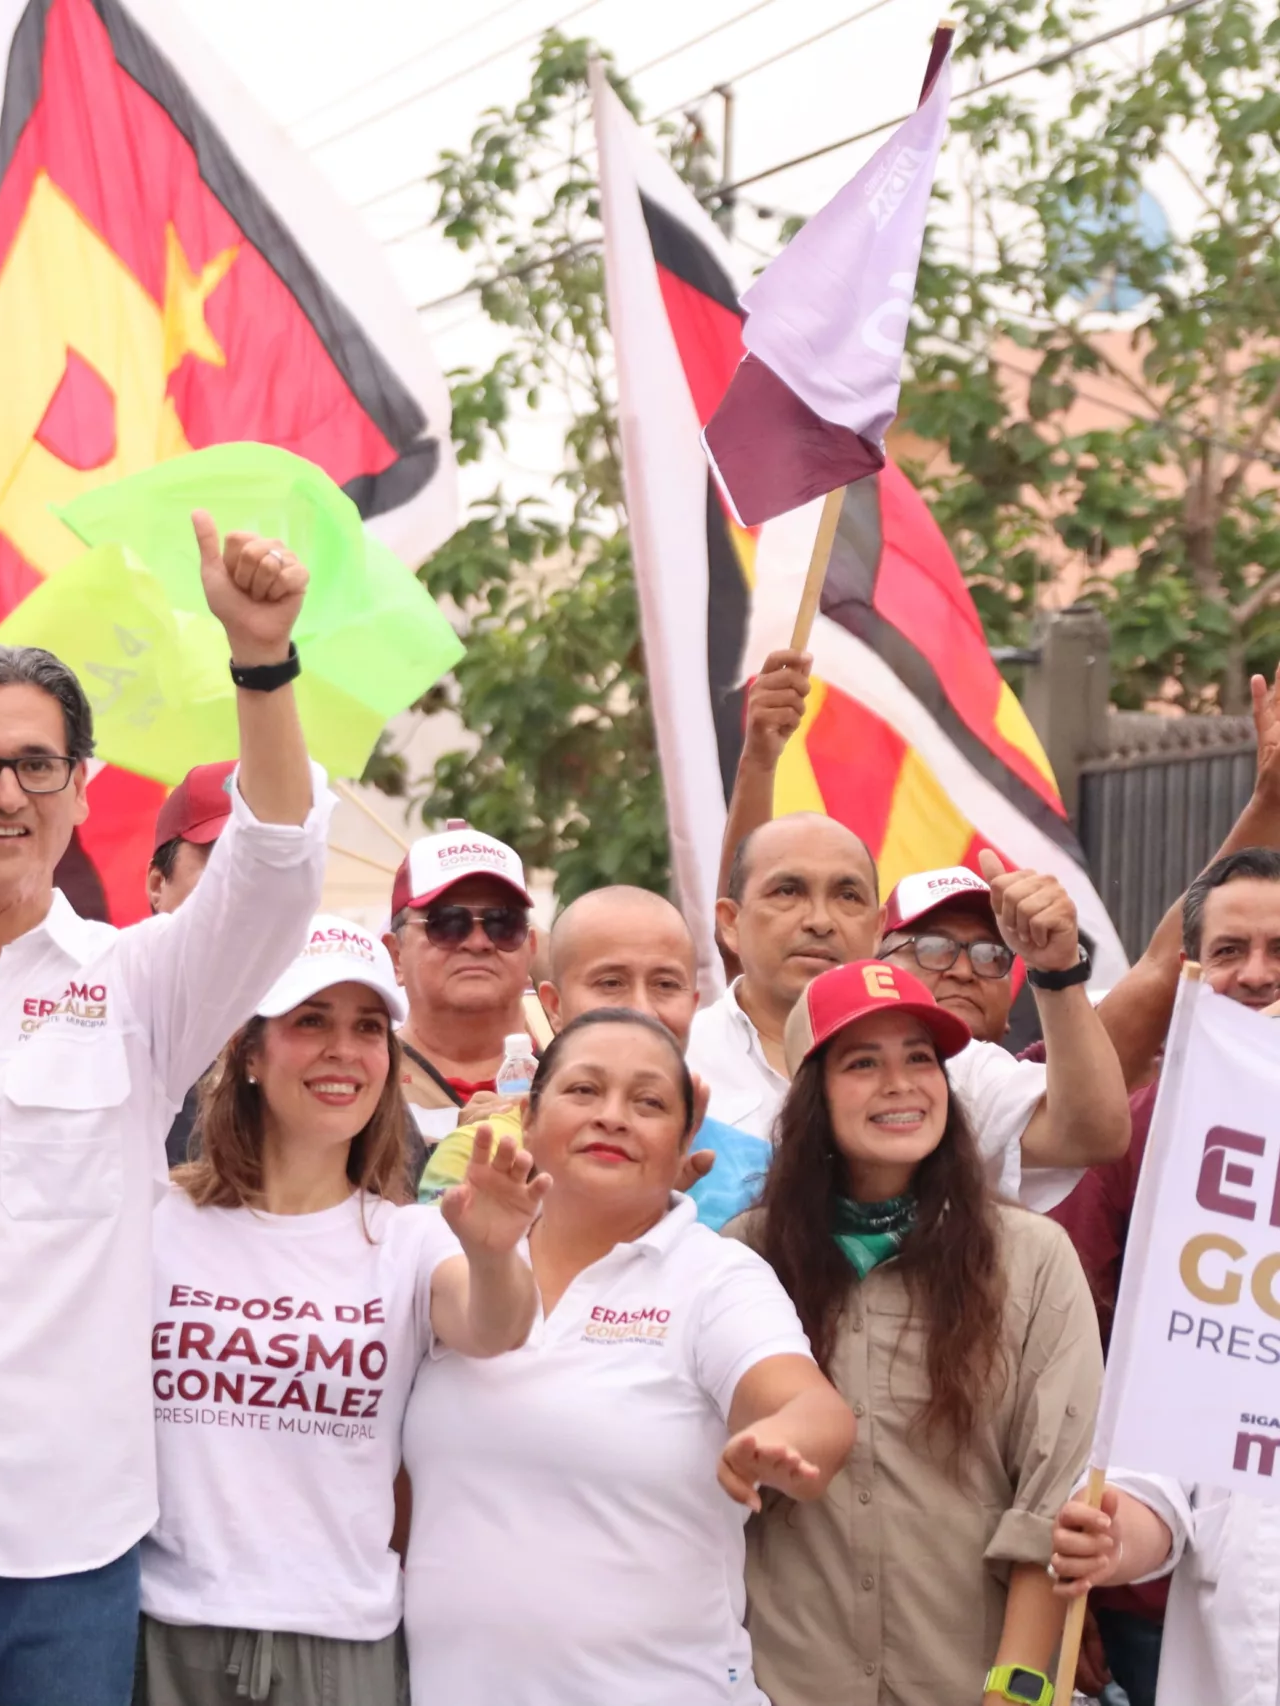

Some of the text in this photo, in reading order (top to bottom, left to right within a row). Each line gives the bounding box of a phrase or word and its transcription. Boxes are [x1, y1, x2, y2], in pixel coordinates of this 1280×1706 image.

[438, 844, 506, 859] ERASMO
[927, 877, 988, 891] ERASM
[310, 928, 373, 951] ASMO
[862, 965, 901, 1000] E
[1196, 1125, 1280, 1229] E
[169, 1284, 385, 1325] ESPOSA DE
[590, 1305, 671, 1324] ERASMO
[151, 1321, 388, 1381] ERASMO
[153, 1369, 384, 1419] GONZÁLEZ
[155, 1407, 375, 1440] PRESIDENTE MUNICIPAL
